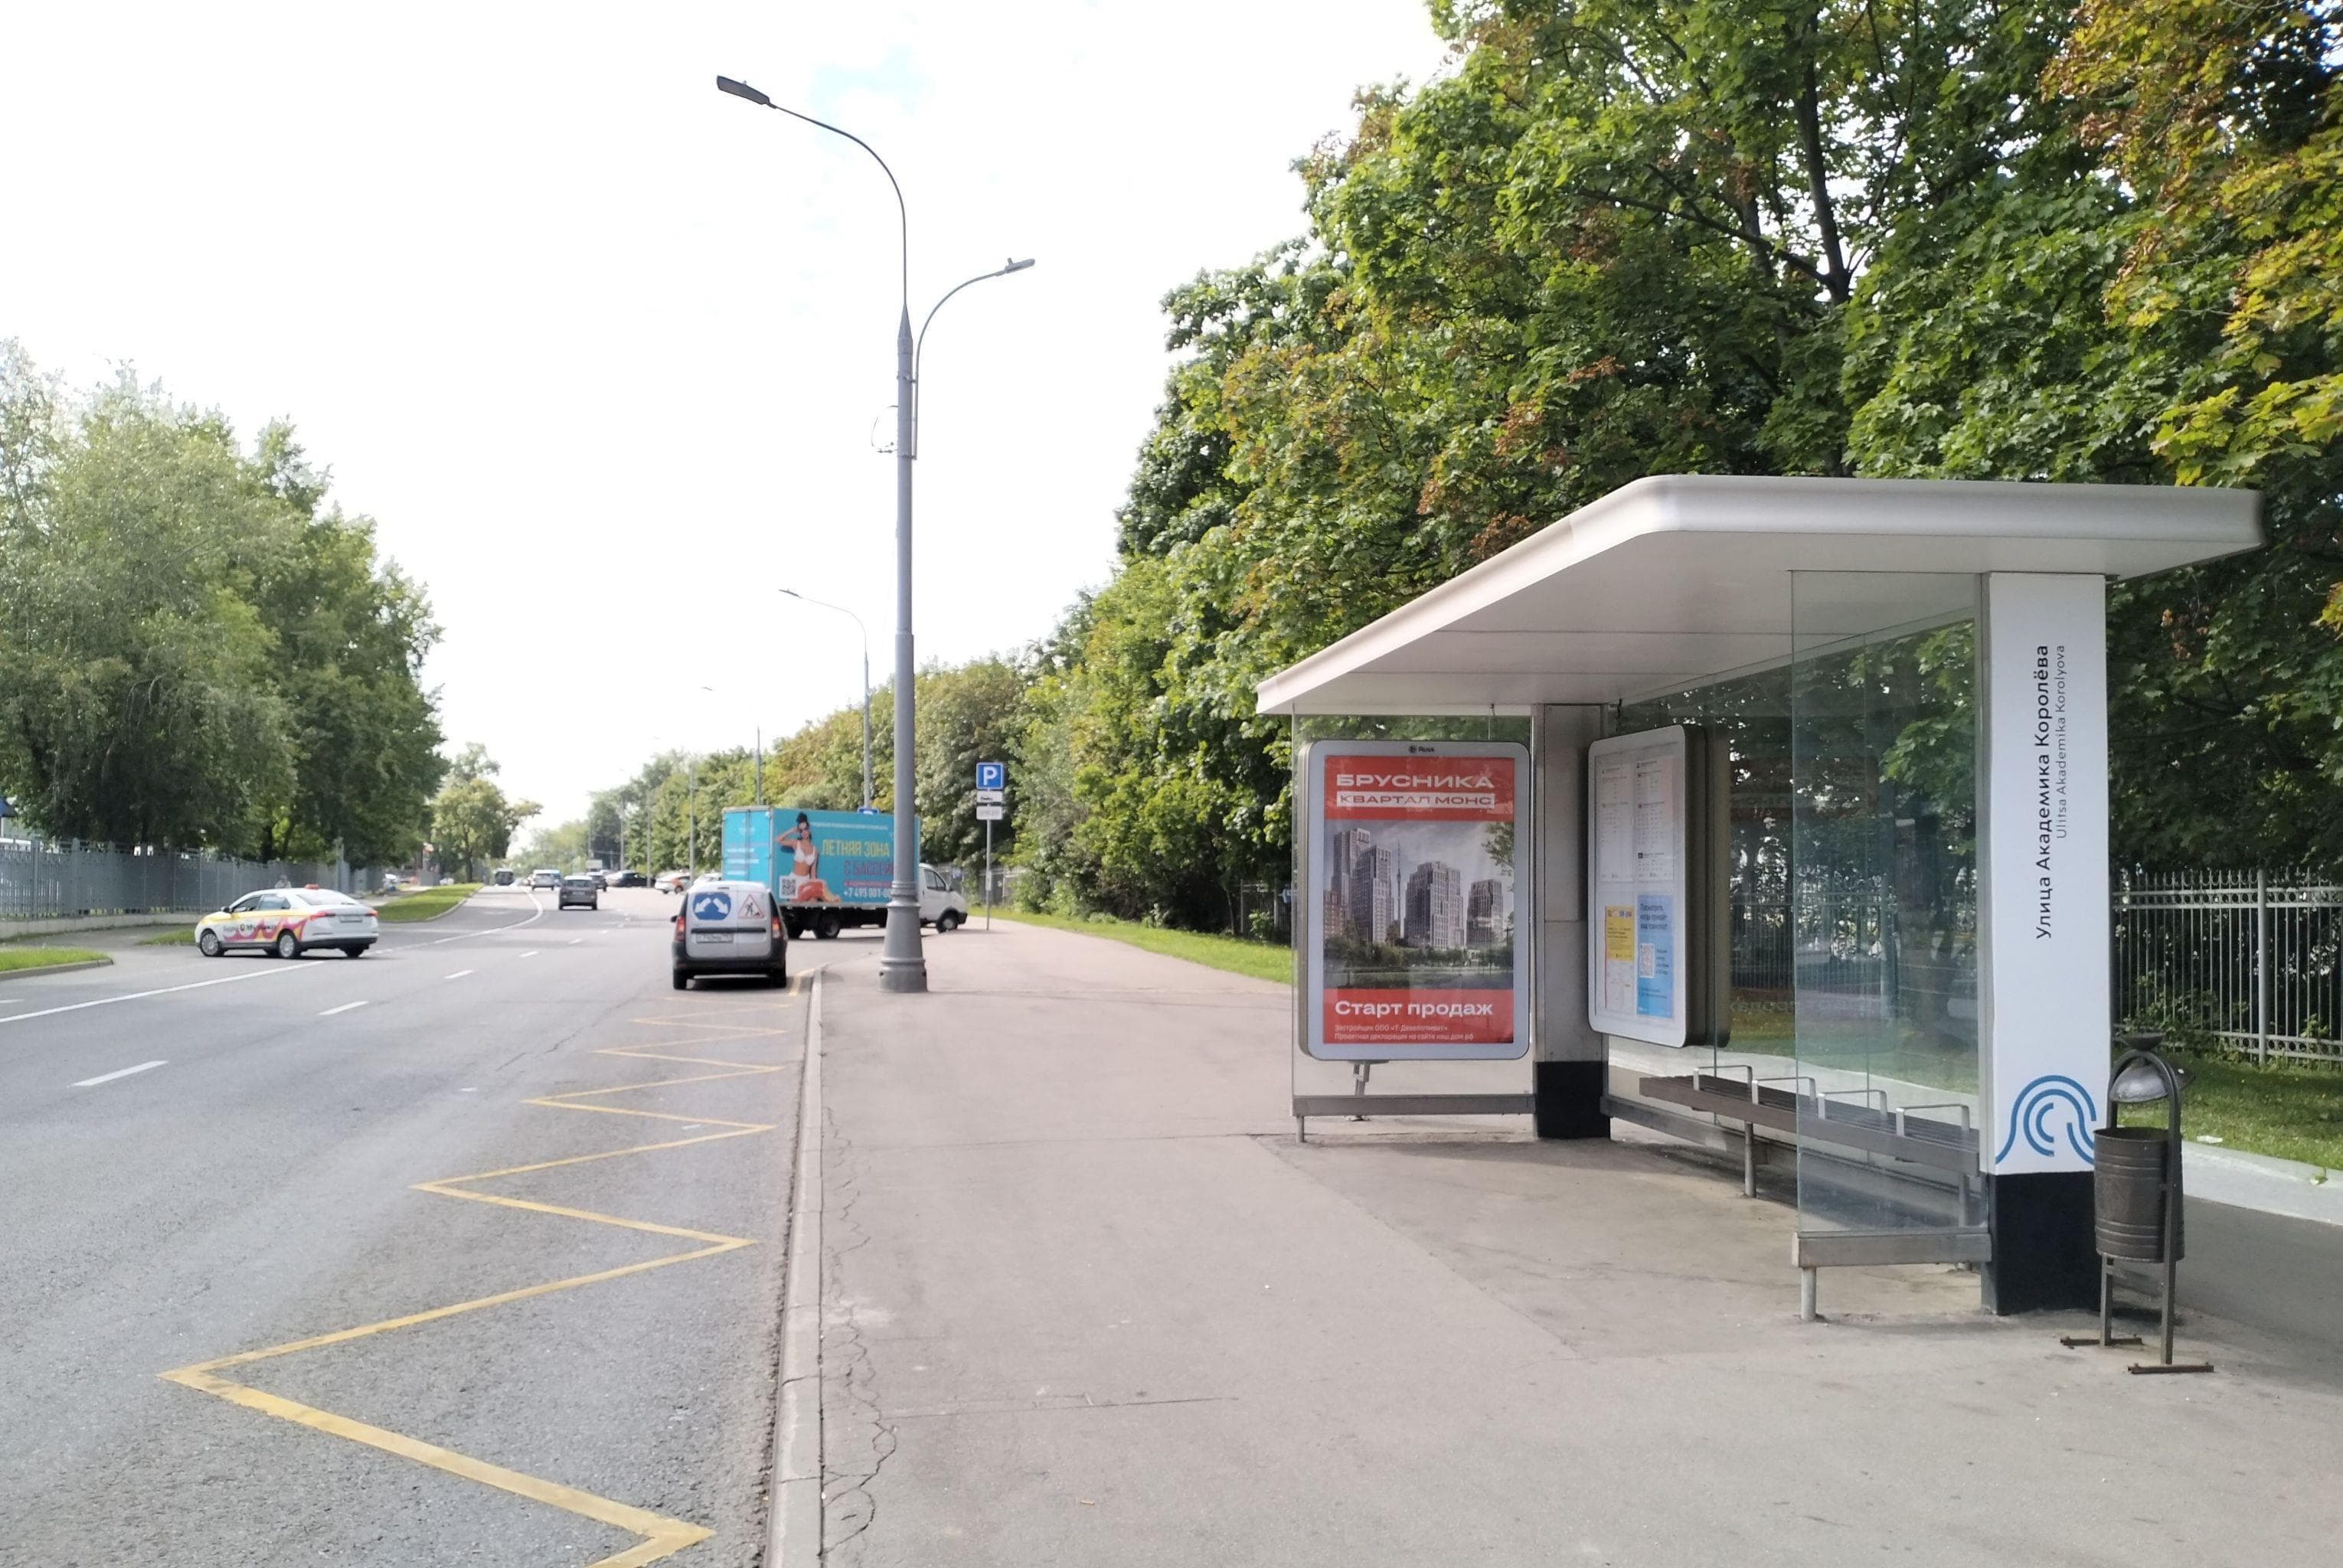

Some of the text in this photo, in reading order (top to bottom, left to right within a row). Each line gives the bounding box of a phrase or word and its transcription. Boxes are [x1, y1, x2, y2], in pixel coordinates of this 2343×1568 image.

[2054, 645, 2067, 838] Ulitsa Akademika Korolyova
[1336, 773, 1495, 789] БРУСНИКА
[1340, 795, 1492, 805] КВАРТАЛ МОНС
[2033, 645, 2053, 939] Улица Академика Королёва
[821, 839, 890, 857] ЛЕТНЯЯ ЗОНА
[1335, 1000, 1494, 1018] Старт продаж
